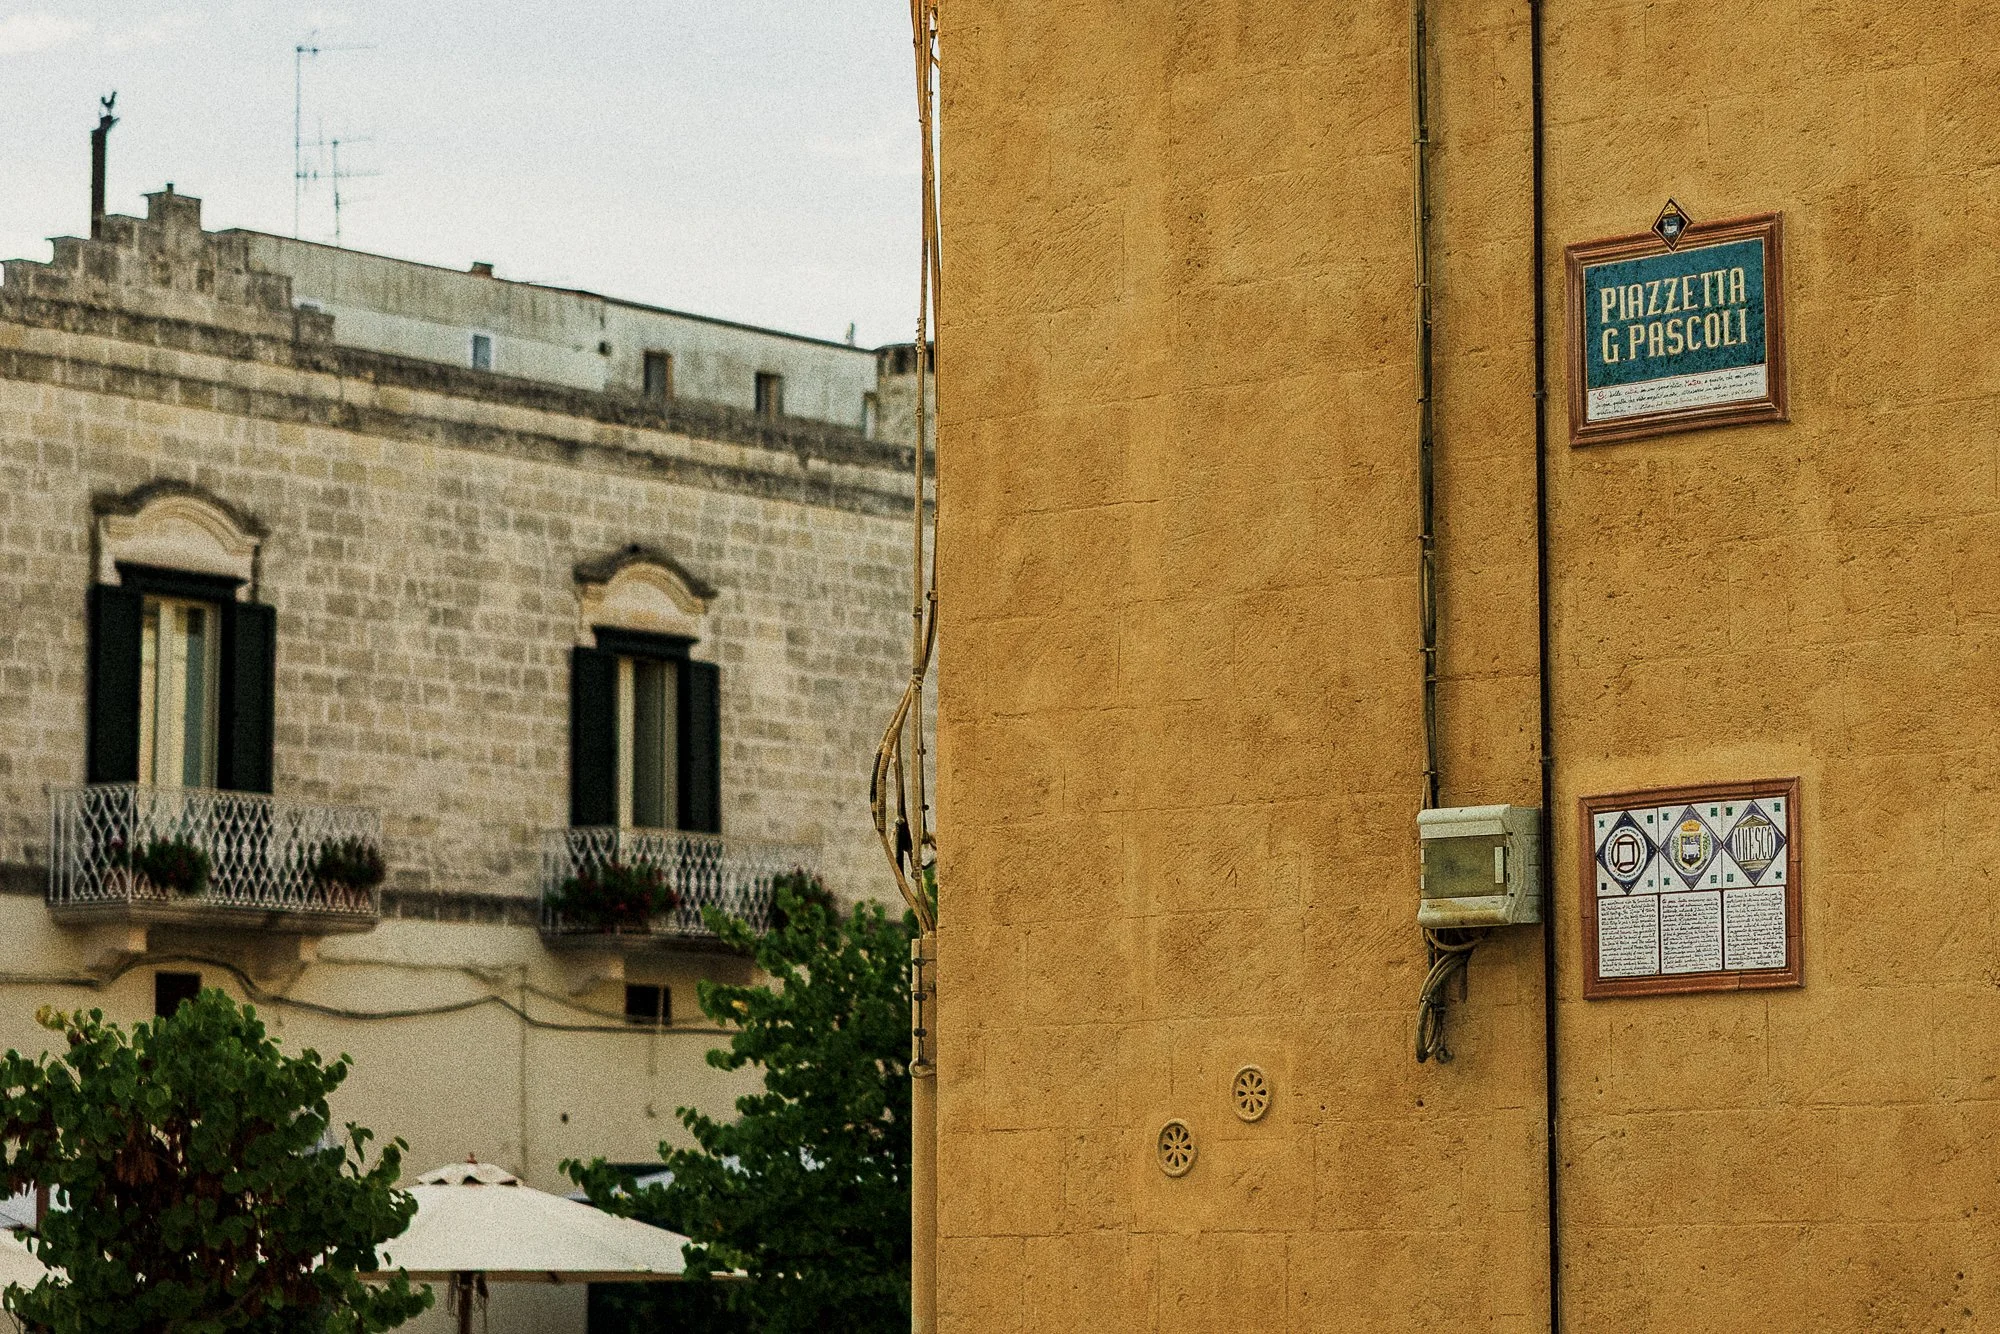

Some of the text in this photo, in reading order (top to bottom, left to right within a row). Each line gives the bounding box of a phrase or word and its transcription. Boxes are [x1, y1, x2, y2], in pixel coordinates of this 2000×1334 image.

[1600, 267, 1746, 324] PIAZZETTA
[1628, 308, 1747, 360] PASCOLI
[1735, 826, 1773, 860] UNESCO
